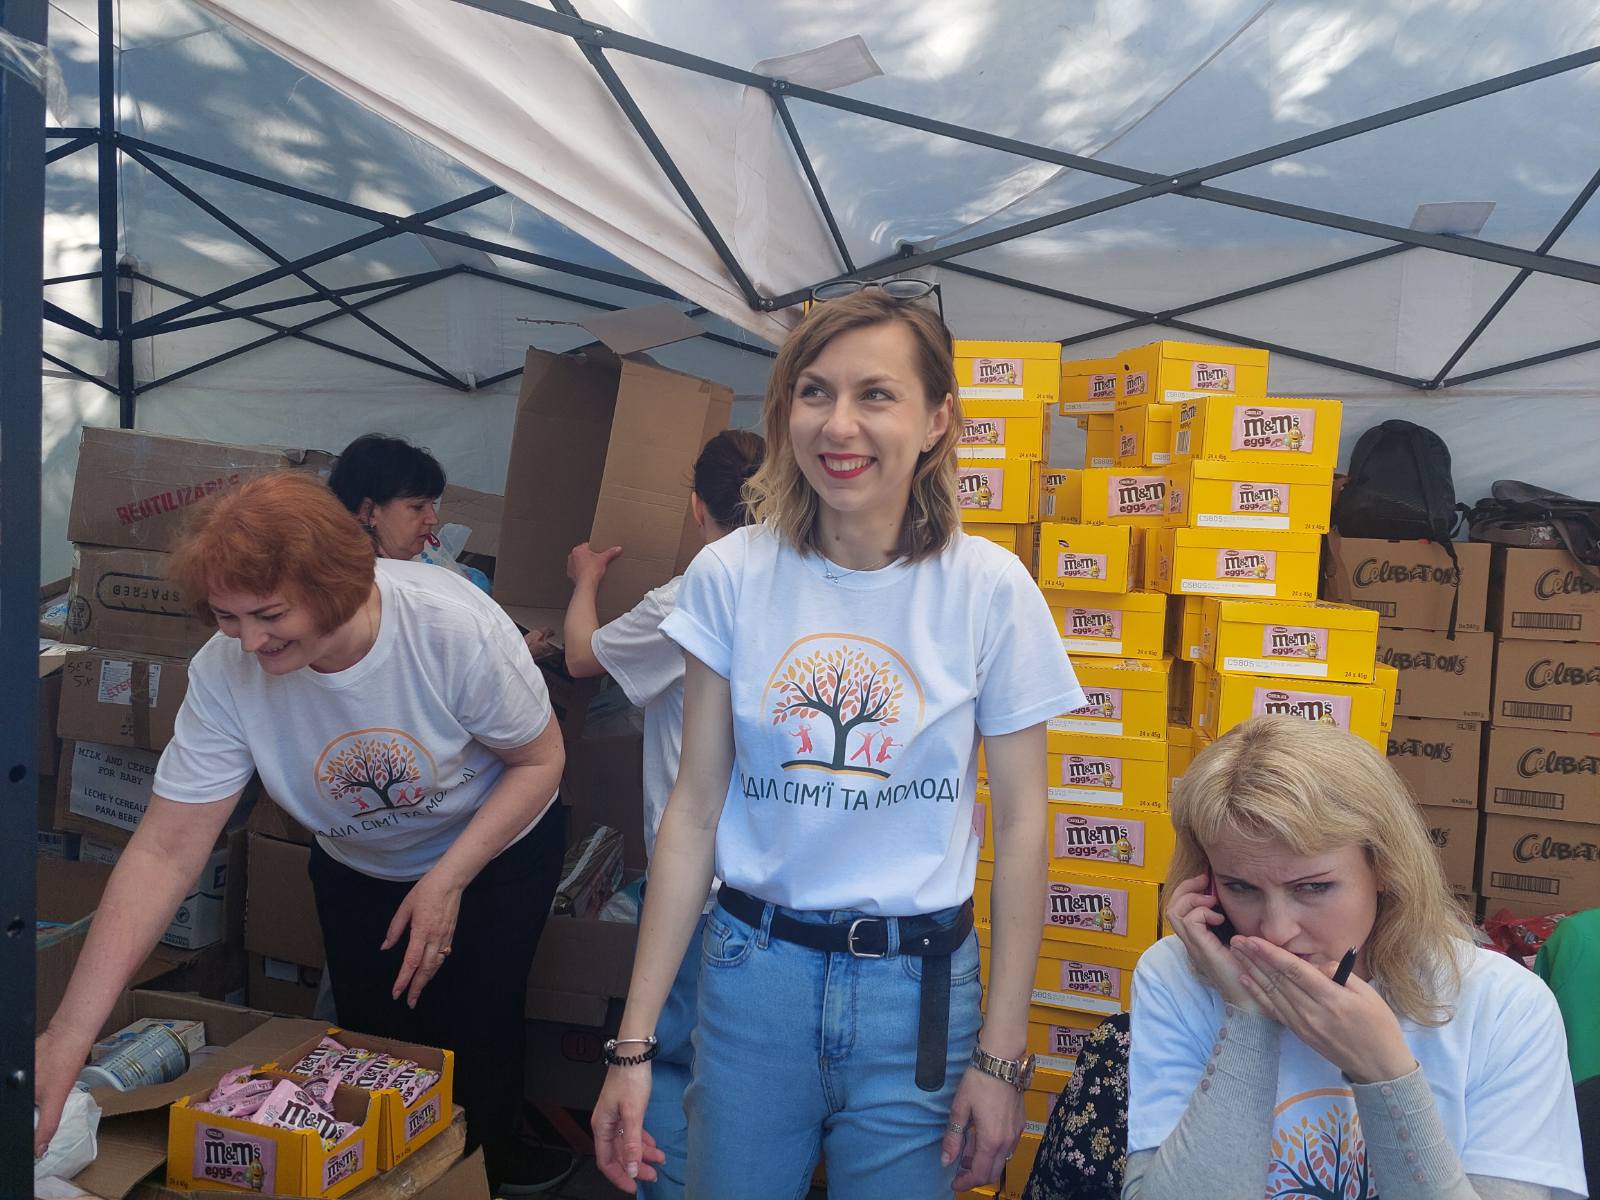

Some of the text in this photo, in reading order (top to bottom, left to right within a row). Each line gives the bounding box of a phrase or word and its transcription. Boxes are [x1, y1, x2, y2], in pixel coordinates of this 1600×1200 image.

[1244, 415, 1300, 437] m&m's
[1244, 436, 1271, 447] eggs
[1240, 488, 1279, 504] m&m's
[1120, 502, 1146, 513] eggs
[1240, 503, 1259, 511] eggs
[1225, 554, 1265, 570] m&m's
[1064, 568, 1080, 576] eggs
[1225, 569, 1245, 577] eggs
[1072, 613, 1111, 628] m&m's
[1072, 627, 1092, 635] eggs
[1272, 632, 1316, 648] m&m's
[1272, 647, 1294, 655] eggs
[1265, 701, 1332, 720] m&m's
[105, 755, 122, 766] AND
[98, 766, 144, 785] FOR BABY
[1069, 762, 1111, 777] m&m's
[1070, 776, 1090, 784] eggs
[84, 785, 107, 801] LECHE
[840, 788, 869, 811] ТА
[876, 778, 959, 809] МОЛОДІ
[95, 804, 116, 818] PARA
[1066, 826, 1128, 845] m&m's
[1068, 846, 1097, 856] eggs
[1050, 894, 1111, 913] m&m's
[1051, 914, 1080, 925] eggs
[1069, 969, 1109, 983] m&m's
[1069, 982, 1089, 990] eggs
[205, 1141, 261, 1166] m&m's
[205, 1166, 232, 1179] eggs
